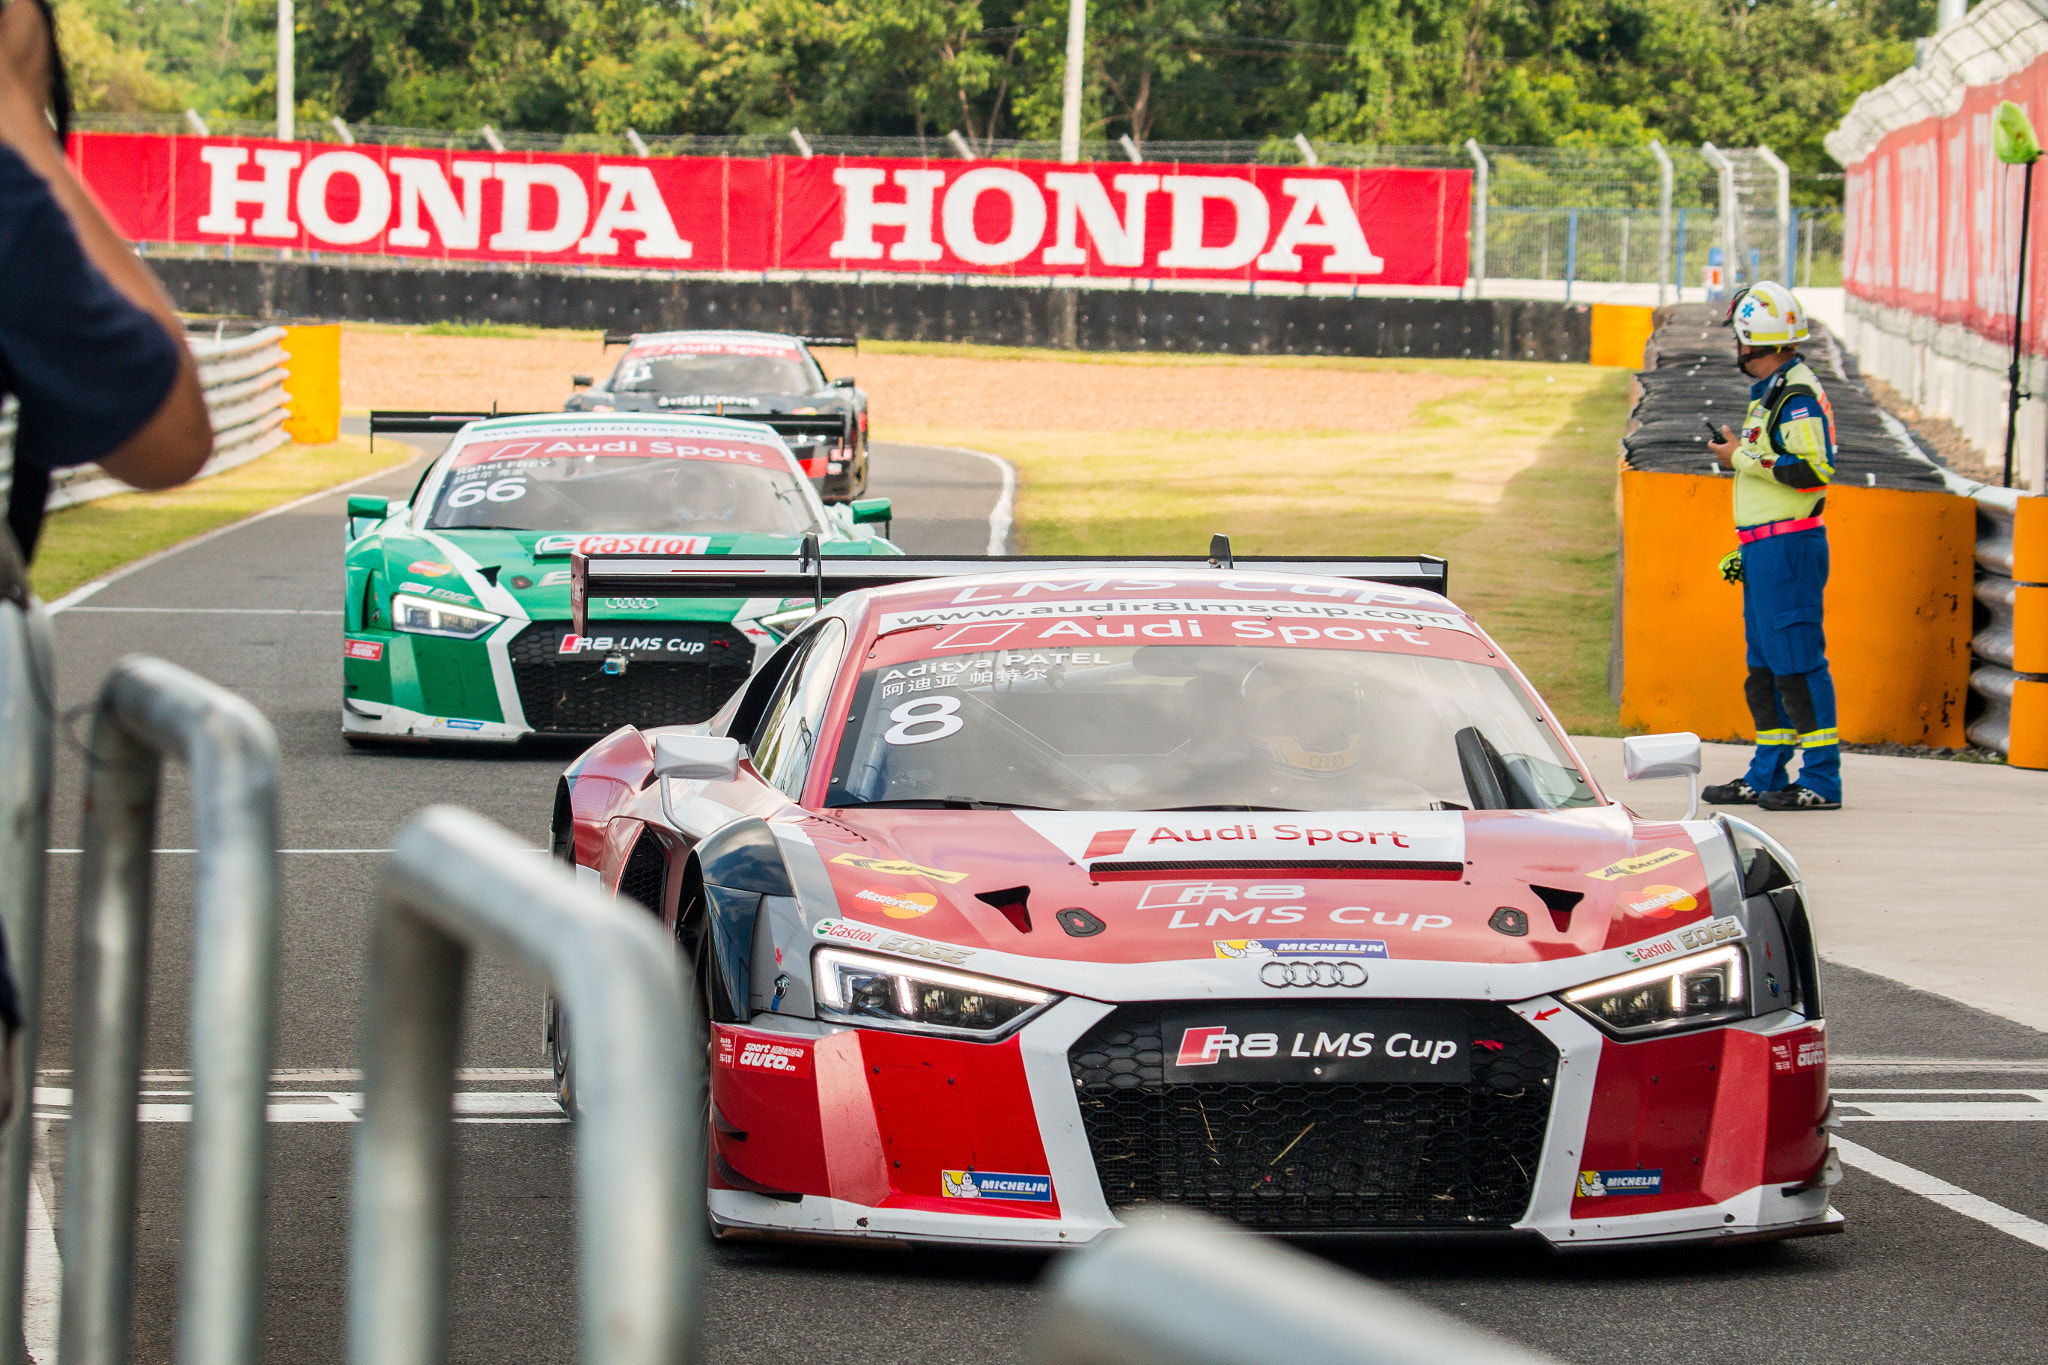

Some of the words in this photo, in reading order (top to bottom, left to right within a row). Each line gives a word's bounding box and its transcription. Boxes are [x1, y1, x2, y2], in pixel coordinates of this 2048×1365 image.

[198, 145, 693, 259] HONDA
[829, 167, 1384, 274] HONDA
[544, 440, 638, 454] Audi
[650, 441, 764, 463] Sport
[456, 462, 502, 476] Rahel
[447, 477, 527, 508] 66
[579, 535, 698, 555] Castrol
[950, 579, 1178, 604] LMS
[1217, 580, 1421, 605] Cup
[896, 601, 1455, 626] www.audir8lmscup.com
[1037, 619, 1203, 639] Audi
[1231, 620, 1430, 646] Sport
[572, 636, 614, 650] R8
[620, 637, 663, 651] LMS
[666, 638, 705, 655] Cup
[880, 658, 993, 684] Aditya
[1005, 652, 1111, 667] PATEL
[882, 674, 959, 700] 阿迪亚
[970, 667, 1048, 684] 帕特尔
[884, 695, 964, 746] 8
[1148, 824, 1257, 845] Audi
[1272, 824, 1410, 848] Sport
[1627, 851, 1679, 870] RACING
[855, 889, 934, 913] MasterCard
[1176, 883, 1306, 903] R8
[1629, 888, 1691, 913] MasterCard
[1168, 906, 1308, 930] LMS
[1329, 906, 1453, 932] Cup
[829, 924, 879, 943] Castrol
[878, 934, 976, 965] EDGE
[1276, 942, 1386, 954] MICHELIN
[1637, 939, 1677, 961] Castrol
[1677, 917, 1741, 950] EDGE
[744, 1042, 771, 1053] sport
[1200, 1033, 1279, 1059] R8
[1290, 1031, 1375, 1058] LMS
[1385, 1033, 1458, 1065] Cup
[739, 1051, 796, 1072] auto.cn
[980, 1180, 1048, 1193] MICHELIN
[1606, 1176, 1661, 1187] MICHELIN
